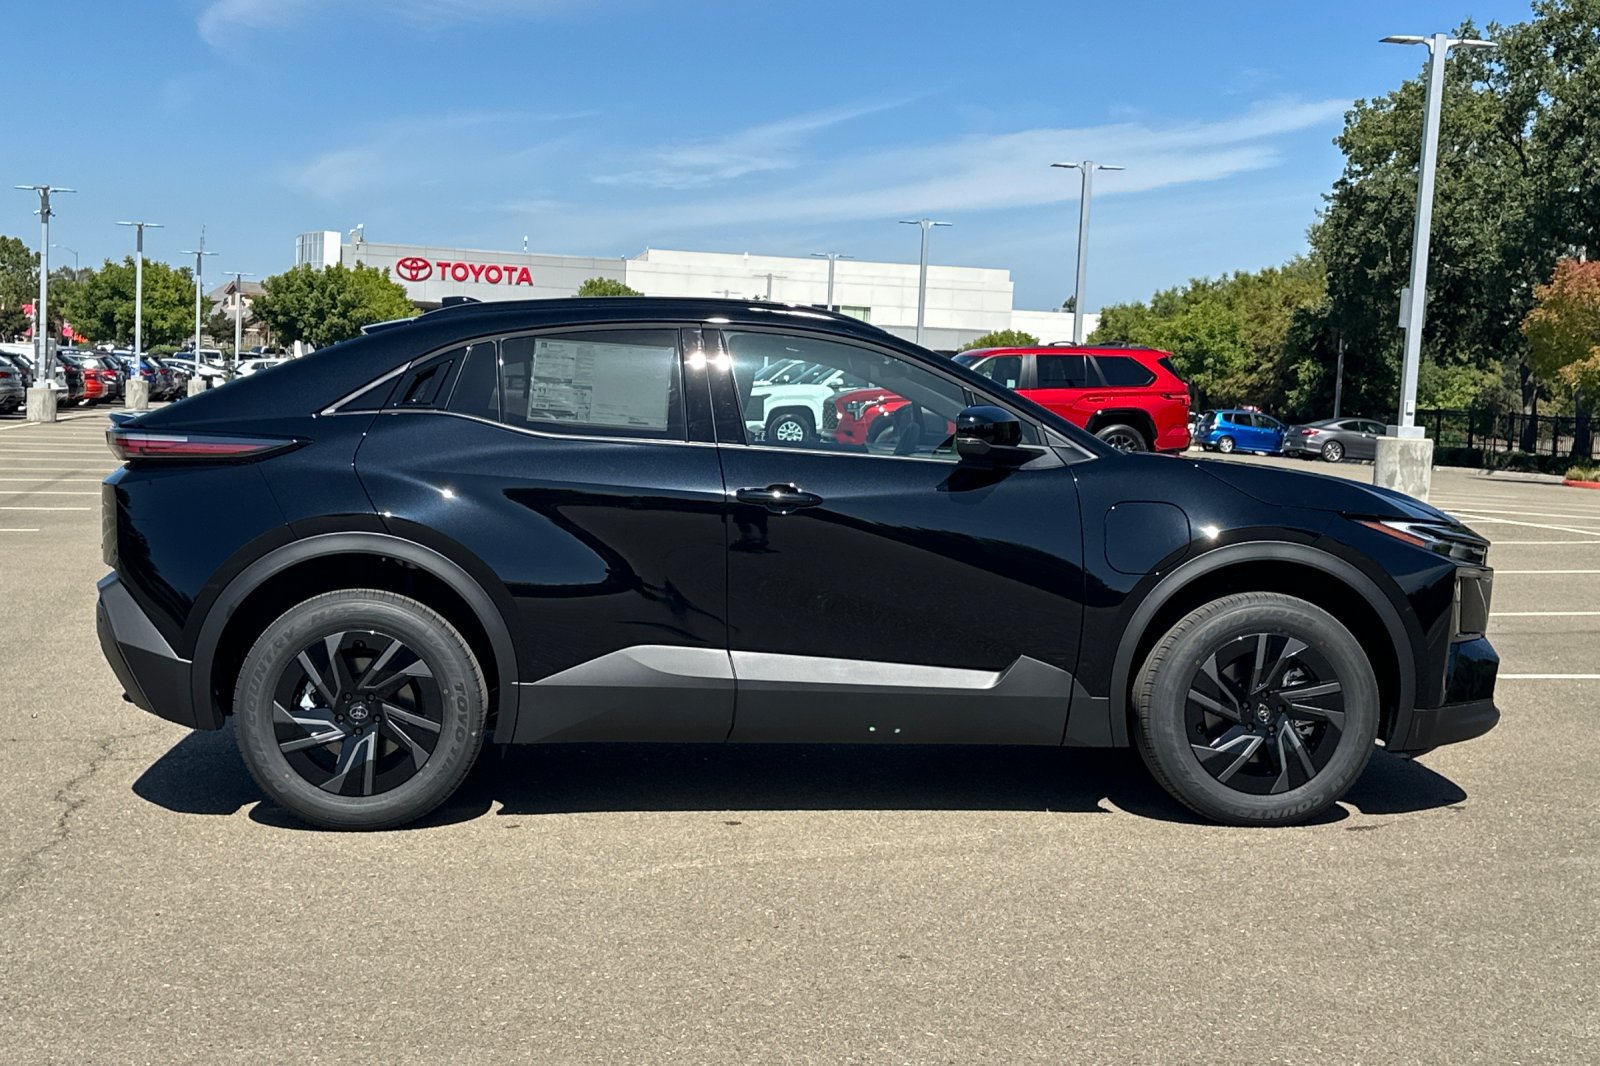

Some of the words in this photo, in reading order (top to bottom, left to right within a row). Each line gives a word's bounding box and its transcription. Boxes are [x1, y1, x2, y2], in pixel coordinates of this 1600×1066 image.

[436, 261, 534, 286] TOYOTA
[246, 626, 295, 726] COUNTRY
[453, 681, 469, 743] TOYO
[1221, 791, 1325, 820] COUNTRY
